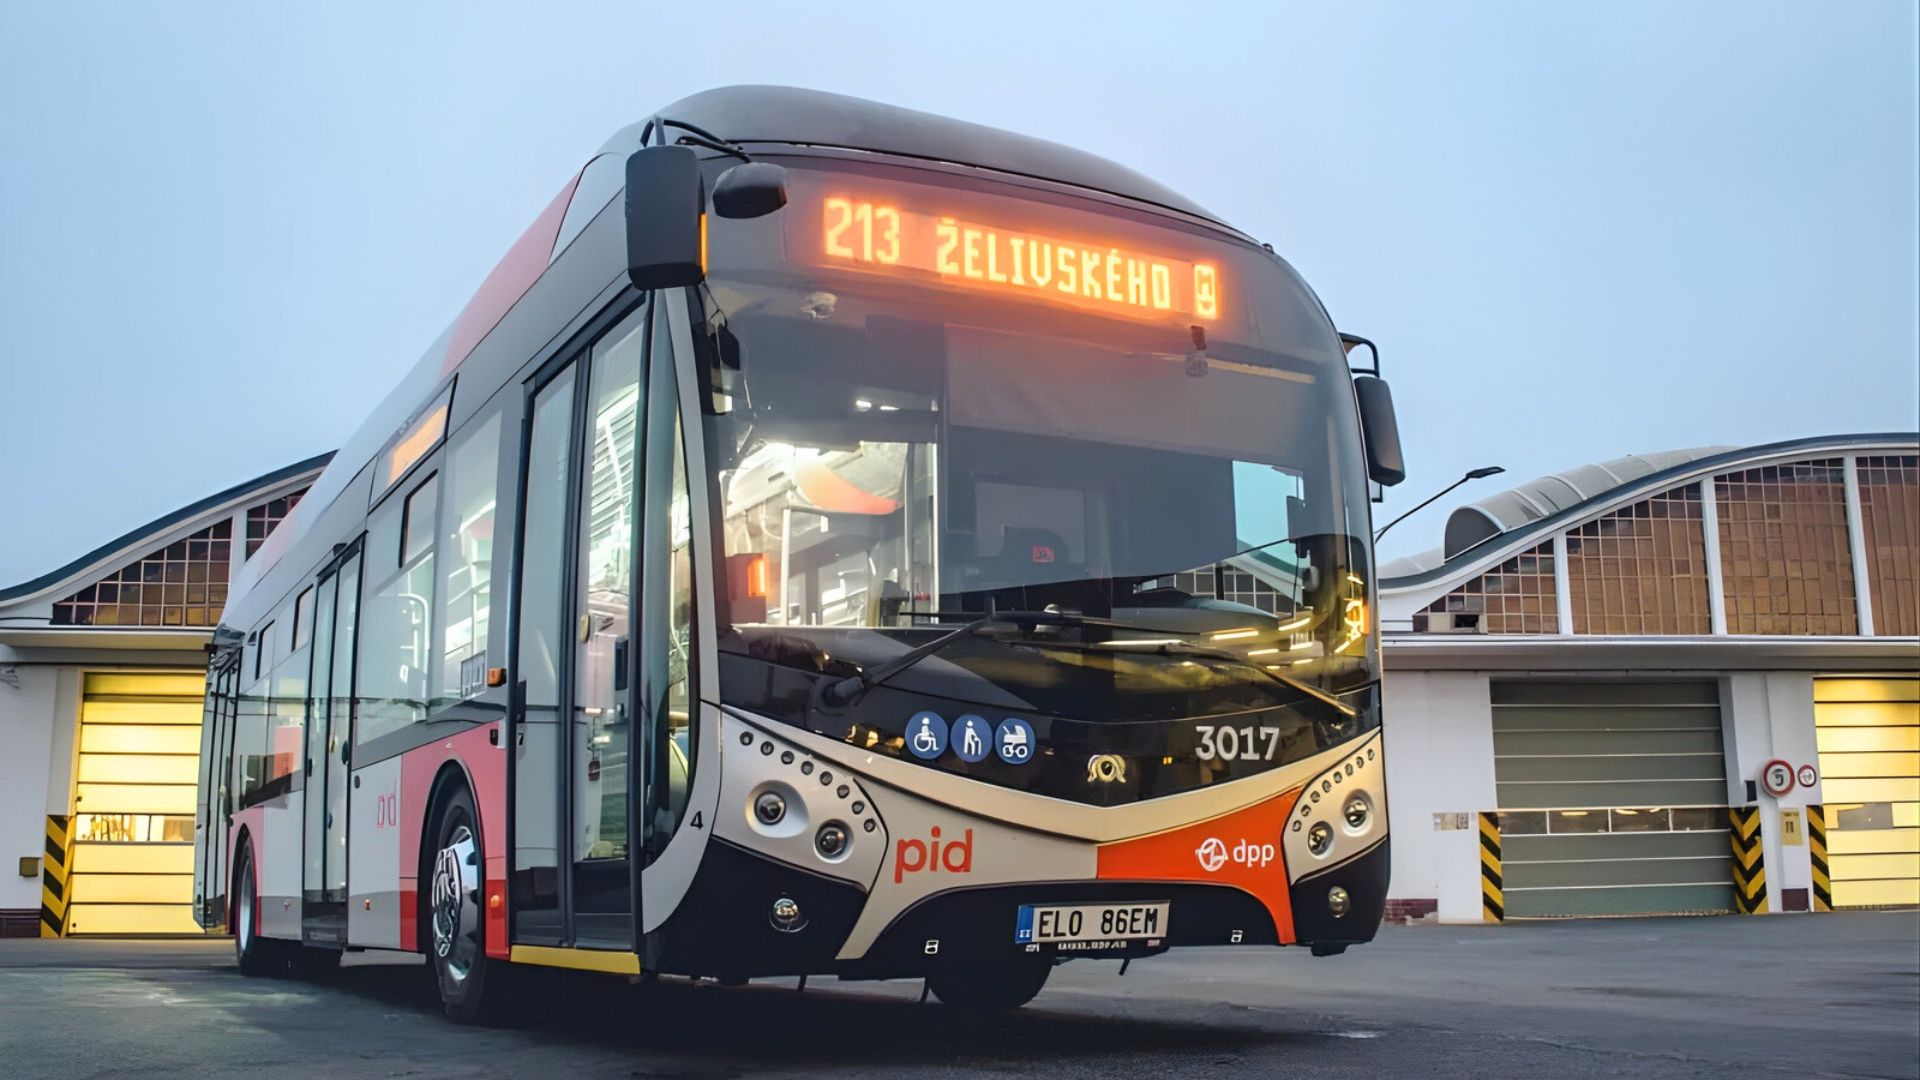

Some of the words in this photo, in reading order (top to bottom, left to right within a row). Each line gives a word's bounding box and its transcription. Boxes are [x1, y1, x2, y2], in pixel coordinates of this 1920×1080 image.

[825, 198, 902, 265] 213
[936, 217, 1172, 310] ŽELIVSKÉHO
[1195, 725, 1280, 762] 3017
[690, 810, 704, 830] 4
[894, 825, 974, 884] pid
[1232, 838, 1275, 868] dpp
[1101, 907, 1159, 935] 86EM
